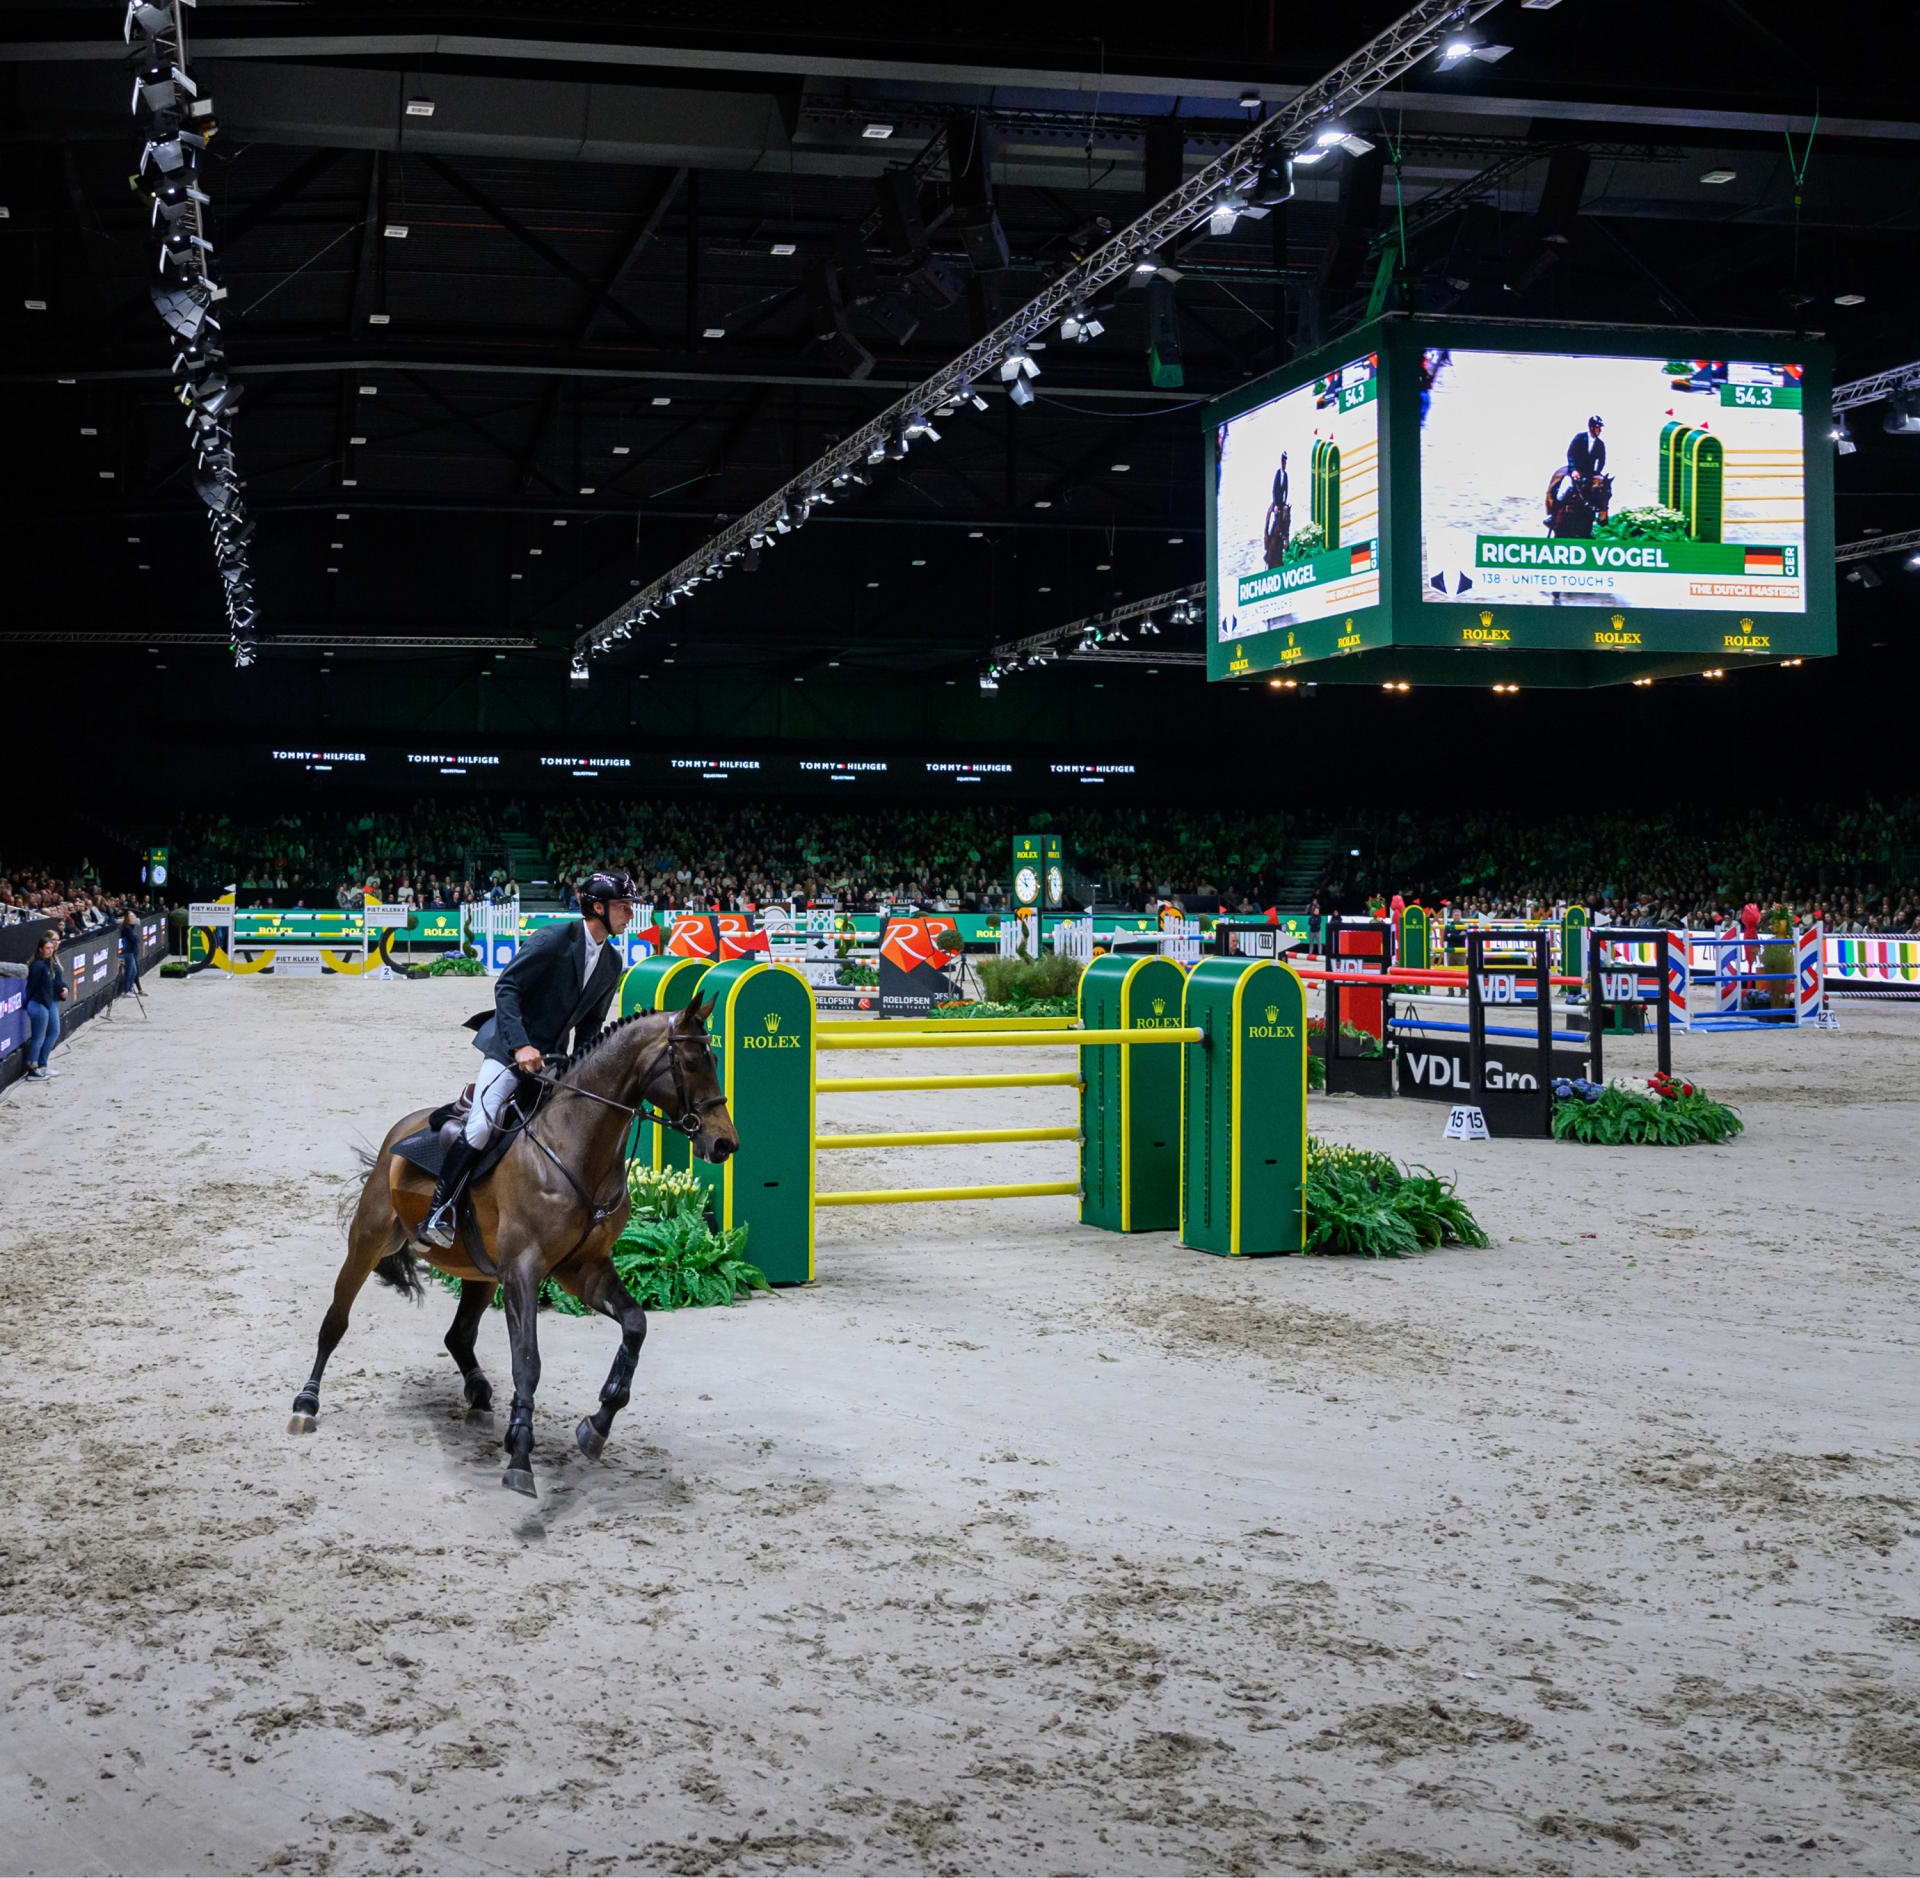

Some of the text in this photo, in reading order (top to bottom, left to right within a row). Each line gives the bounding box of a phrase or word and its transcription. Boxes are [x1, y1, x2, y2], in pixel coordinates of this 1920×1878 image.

[1345, 388, 1365, 407] 54.3
[1735, 387, 1772, 406] 54.3
[1482, 543, 1670, 568] RICHARD VOGEL
[1784, 547, 1795, 576] GER
[1239, 564, 1317, 602] RICHARD VOGEL
[1482, 573, 1501, 584] 138
[1512, 574, 1558, 586] UNITED
[1561, 575, 1603, 587] TOUCH
[1607, 577, 1615, 587] S
[1691, 583, 1799, 597] THE DUTCH MASTERS
[1338, 634, 1361, 648] ROLEX
[1462, 629, 1511, 641] ROLEX
[1594, 632, 1641, 644] ROLEX
[1724, 635, 1770, 647] ROLEX
[1281, 647, 1302, 660] ROLEX
[1230, 658, 1249, 671] ROLEX
[272, 752, 366, 761] TOMMY HILFIGER
[407, 755, 500, 764] TOMMY HILFIGER
[800, 762, 836, 770] TOMMY
[973, 764, 1012, 772] HILFIGER
[1096, 765, 1135, 773] HILFIGER
[424, 928, 458, 936] ROLEX
[383, 968, 390, 976] 2
[1476, 974, 1522, 1003] VDL
[1600, 973, 1645, 1001] VDL
[815, 996, 854, 1005] OELOFSEN
[882, 996, 930, 1004] ROELOFSEN
[1137, 1018, 1181, 1029] ROLEX
[1249, 1026, 1295, 1038] ROLEX
[743, 1035, 801, 1049] ROLEX
[1406, 1052, 1471, 1090] VDL
[1451, 1110, 1464, 1128] 15
[1467, 1111, 1484, 1129] 15
